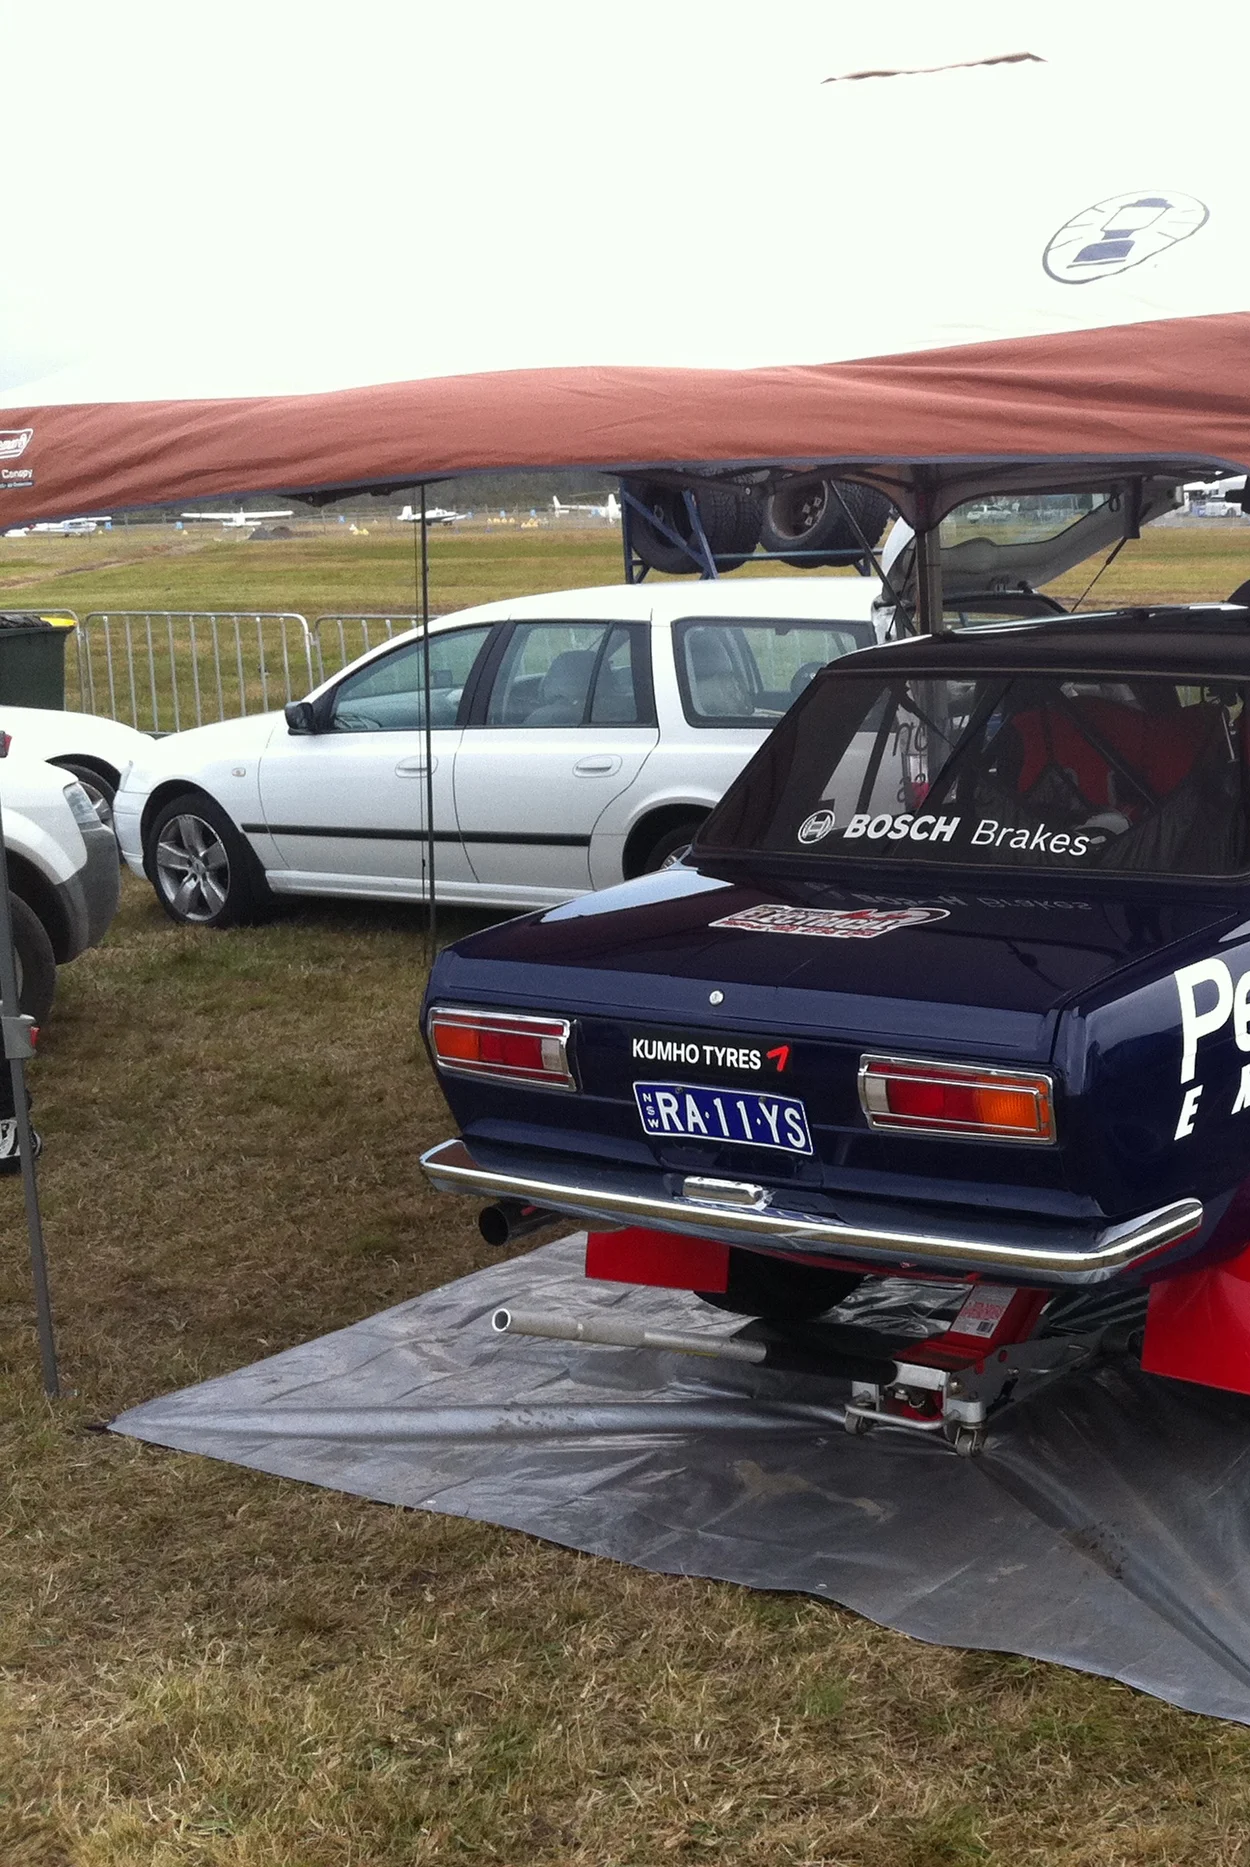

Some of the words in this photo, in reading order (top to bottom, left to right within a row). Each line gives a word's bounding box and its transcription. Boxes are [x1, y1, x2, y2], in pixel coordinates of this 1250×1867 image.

[843, 814, 961, 842] BOSCH
[971, 819, 1091, 857] Brakes
[632, 1038, 700, 1064] KUMHO
[702, 1045, 762, 1070] TYRES
